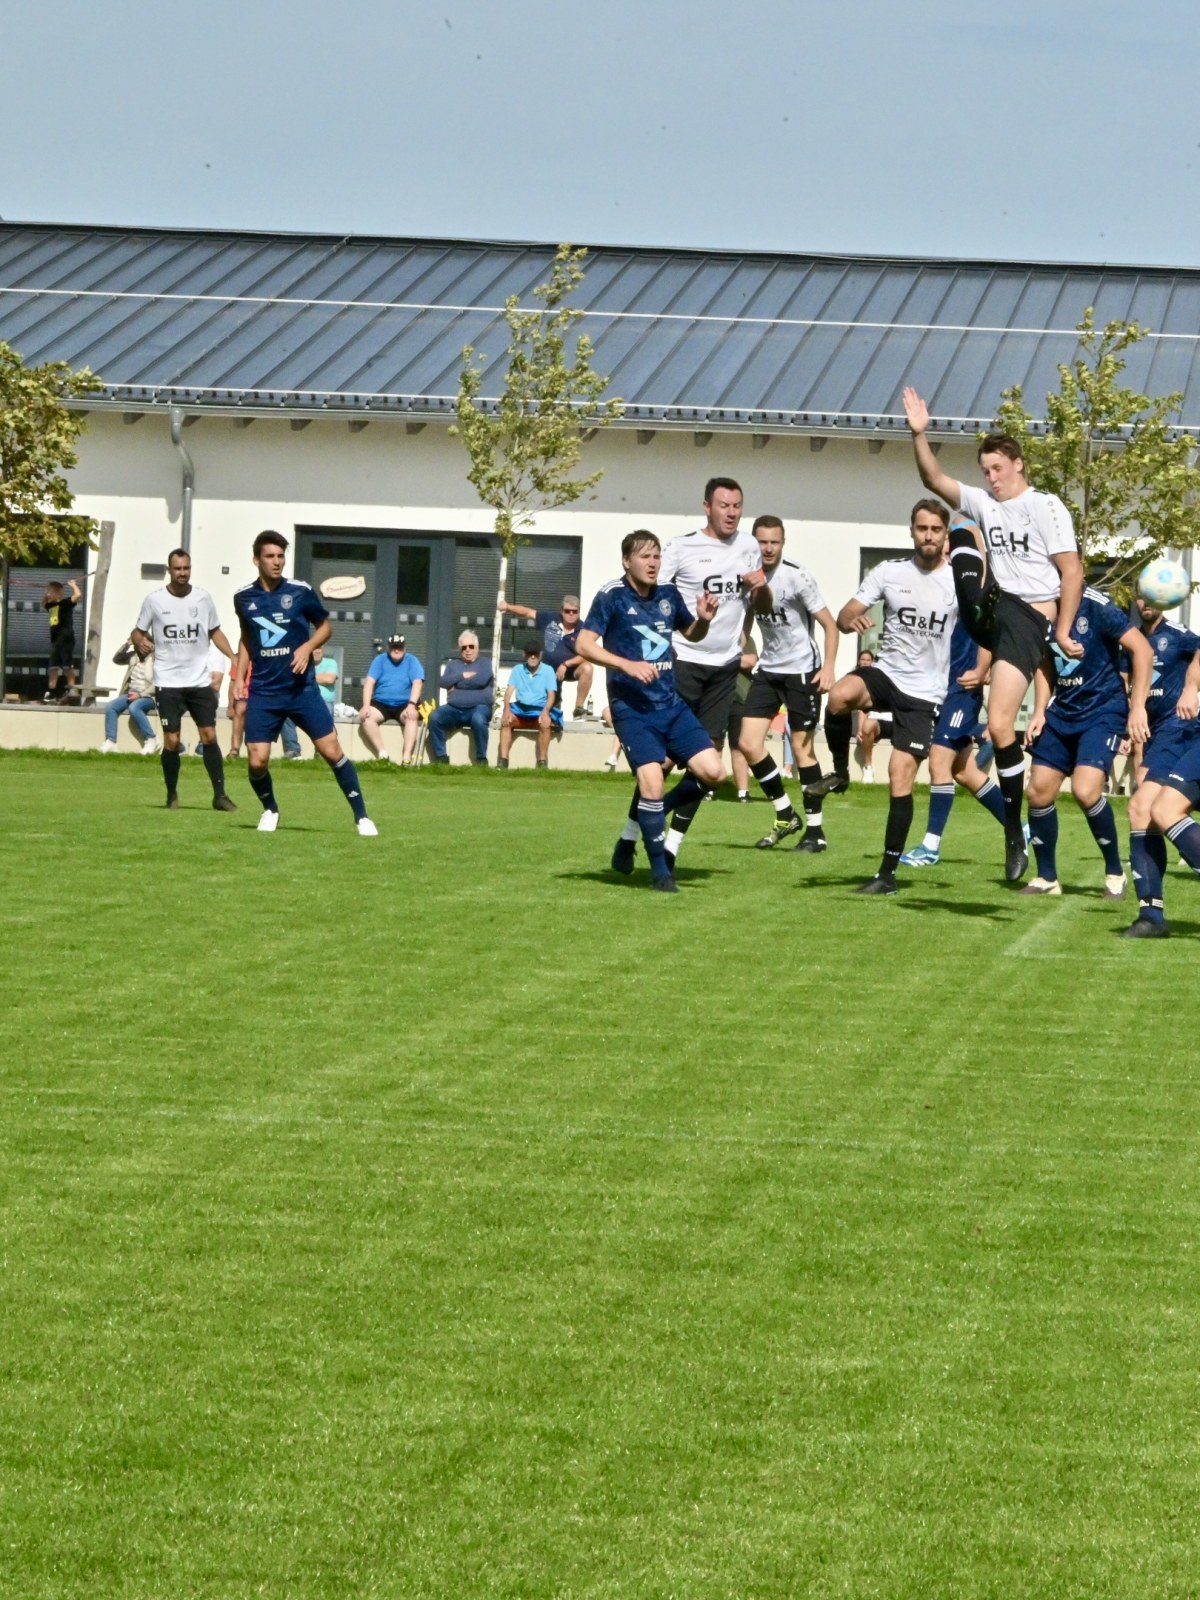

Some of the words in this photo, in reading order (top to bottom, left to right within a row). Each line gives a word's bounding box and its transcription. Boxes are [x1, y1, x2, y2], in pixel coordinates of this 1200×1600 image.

[897, 607, 949, 633] G&H
[162, 623, 200, 639] G&H
[260, 646, 290, 657] DELTIN
